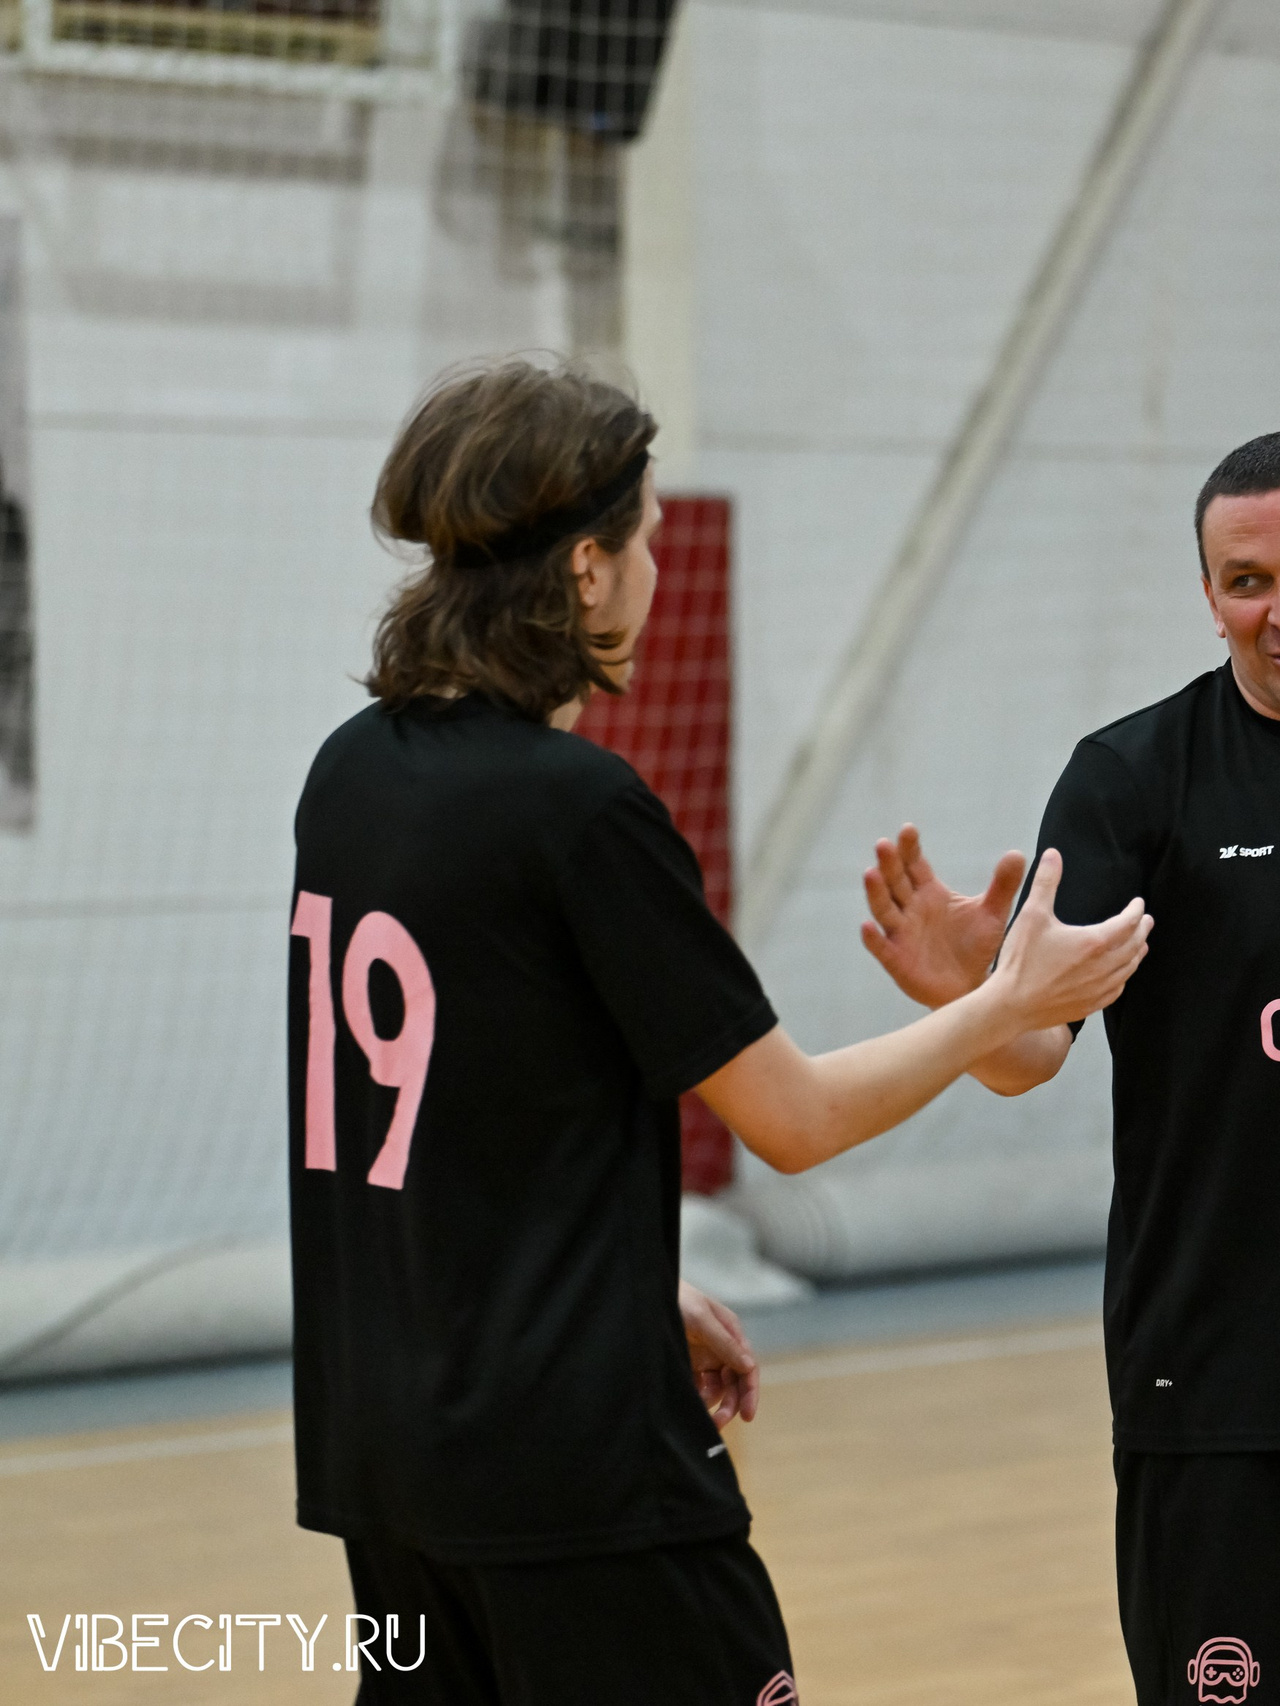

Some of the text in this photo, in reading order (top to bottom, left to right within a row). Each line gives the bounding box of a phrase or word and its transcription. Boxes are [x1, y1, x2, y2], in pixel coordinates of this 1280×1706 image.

[1219, 845, 1275, 859] 2K SPORT
[291, 890, 436, 1190] 19
